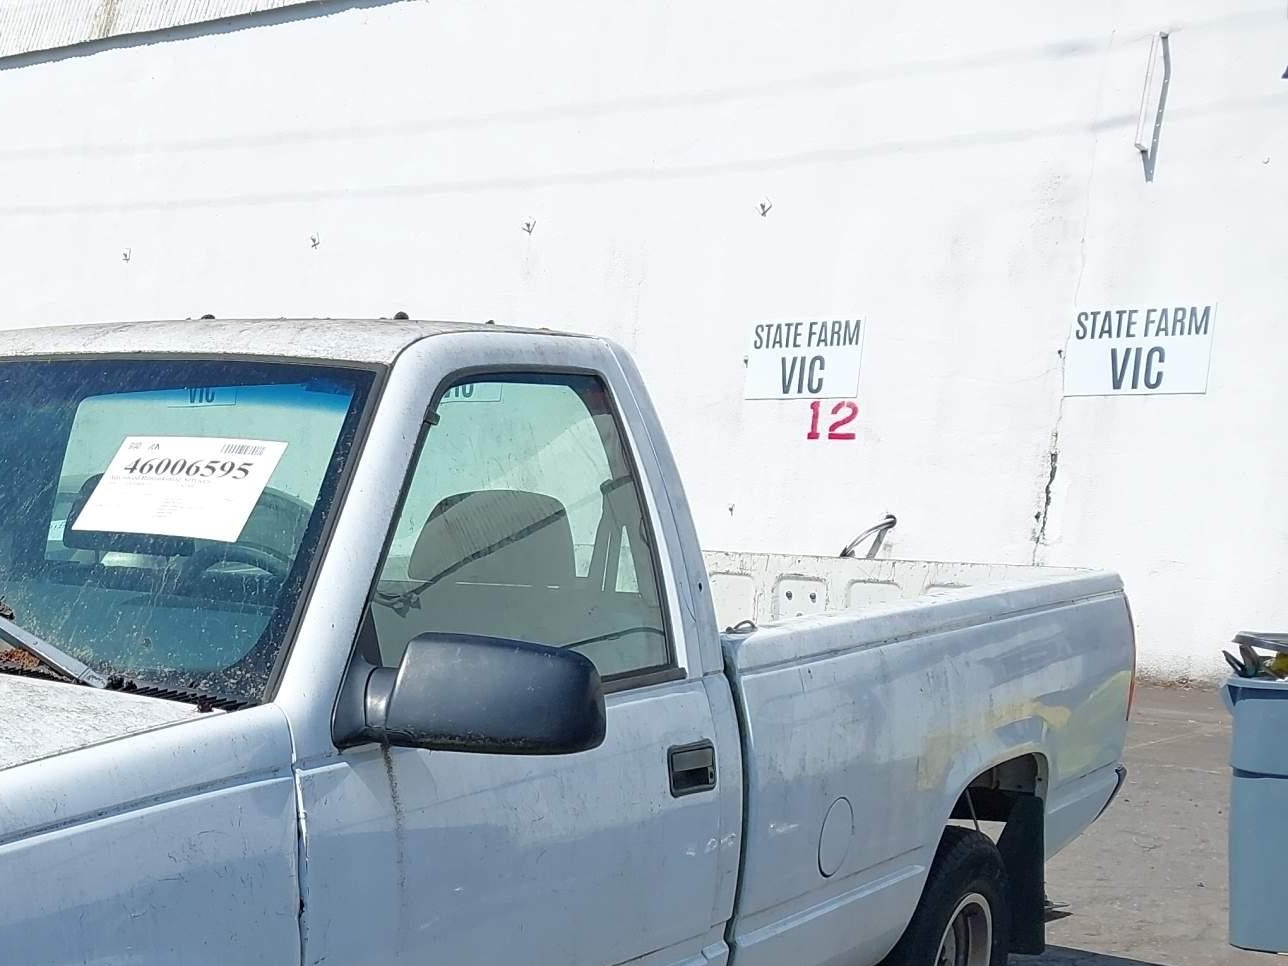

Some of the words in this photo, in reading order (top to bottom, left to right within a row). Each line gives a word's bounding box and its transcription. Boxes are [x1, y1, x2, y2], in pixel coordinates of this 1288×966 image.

[753, 322, 804, 350] STATE
[807, 319, 862, 347] FARM
[1076, 309, 1139, 341] STATE
[1143, 305, 1212, 338] FARM
[781, 355, 826, 395] VIC
[1110, 346, 1166, 390] VIC
[807, 400, 859, 441] 12
[123, 457, 255, 481] 46006595
